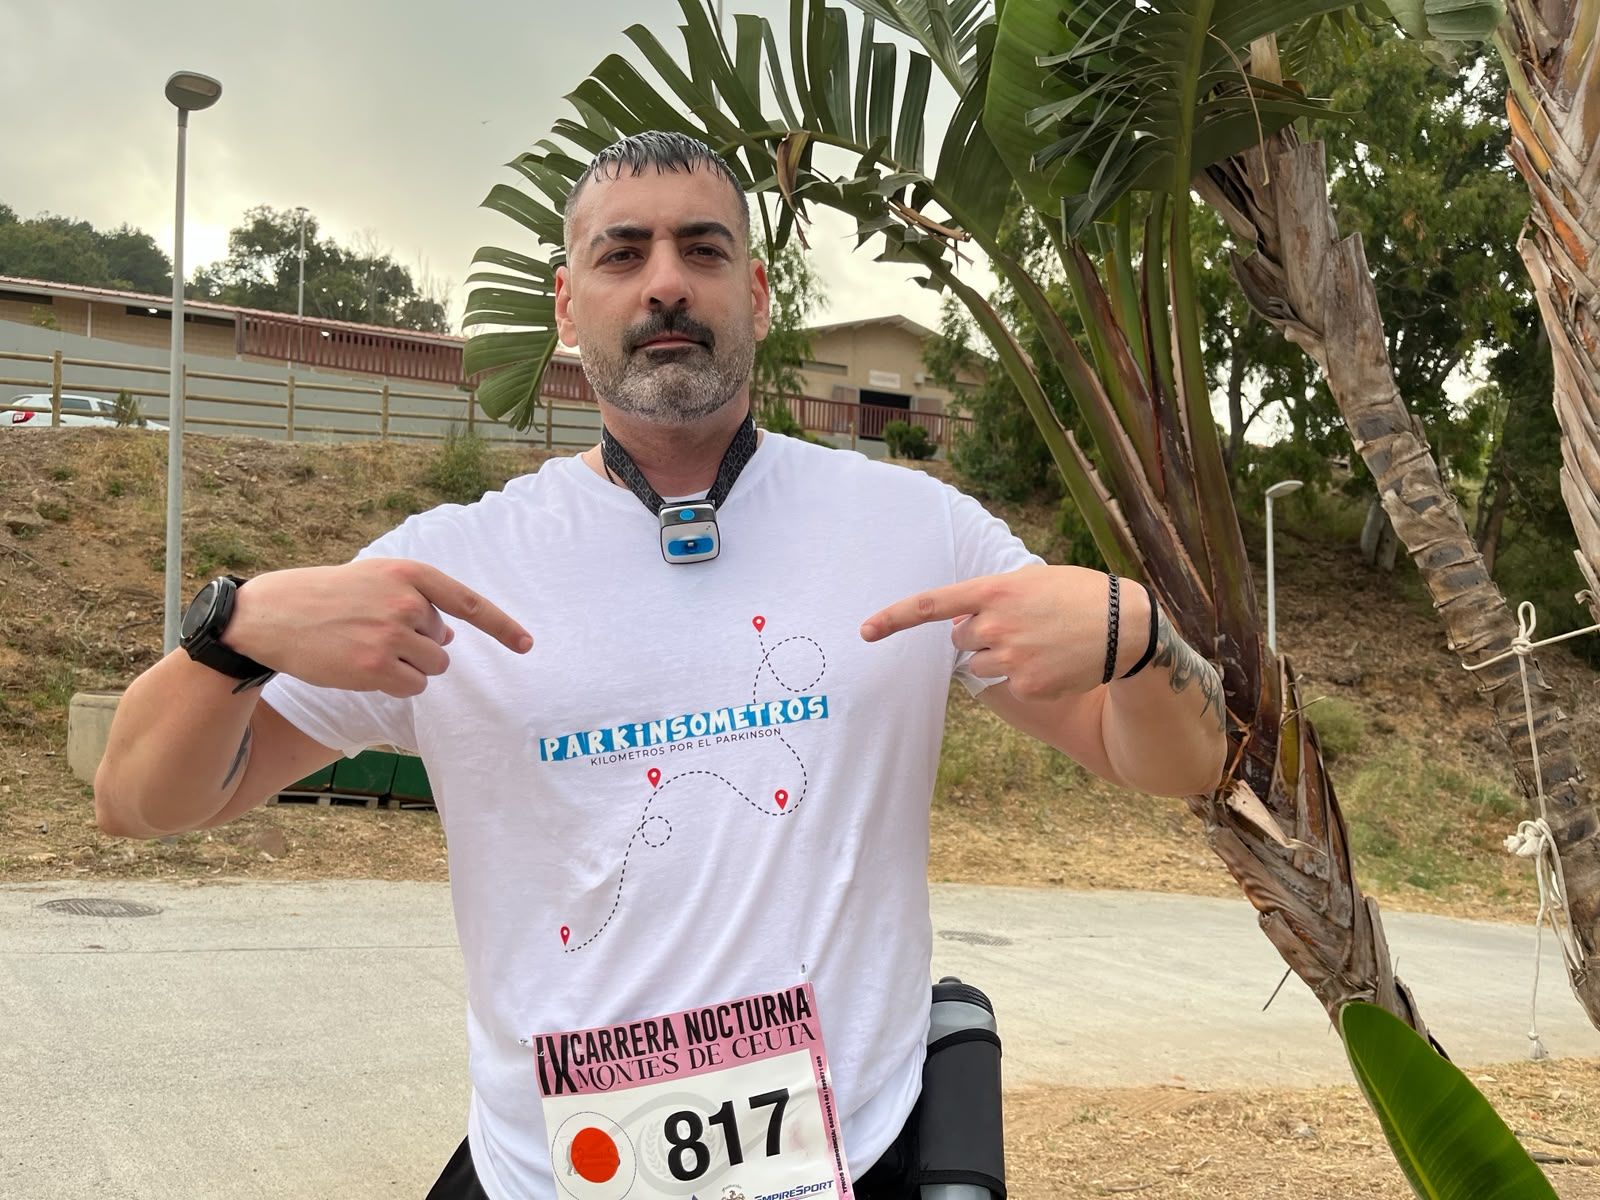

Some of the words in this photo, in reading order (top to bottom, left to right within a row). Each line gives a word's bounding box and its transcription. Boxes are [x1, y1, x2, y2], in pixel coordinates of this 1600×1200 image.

[590, 747, 665, 766] KILOMETROS
[670, 741, 694, 753] POR
[698, 738, 712, 748] EL
[716, 728, 782, 745] PARKINSON
[535, 1035, 578, 1096] IX
[570, 1017, 680, 1066] CARRERA
[684, 987, 812, 1046] NOCTURNA
[575, 1051, 679, 1091] MONTES
[690, 1042, 724, 1070] DE
[732, 1022, 816, 1060] CEUTA
[663, 1088, 790, 1182] 817
